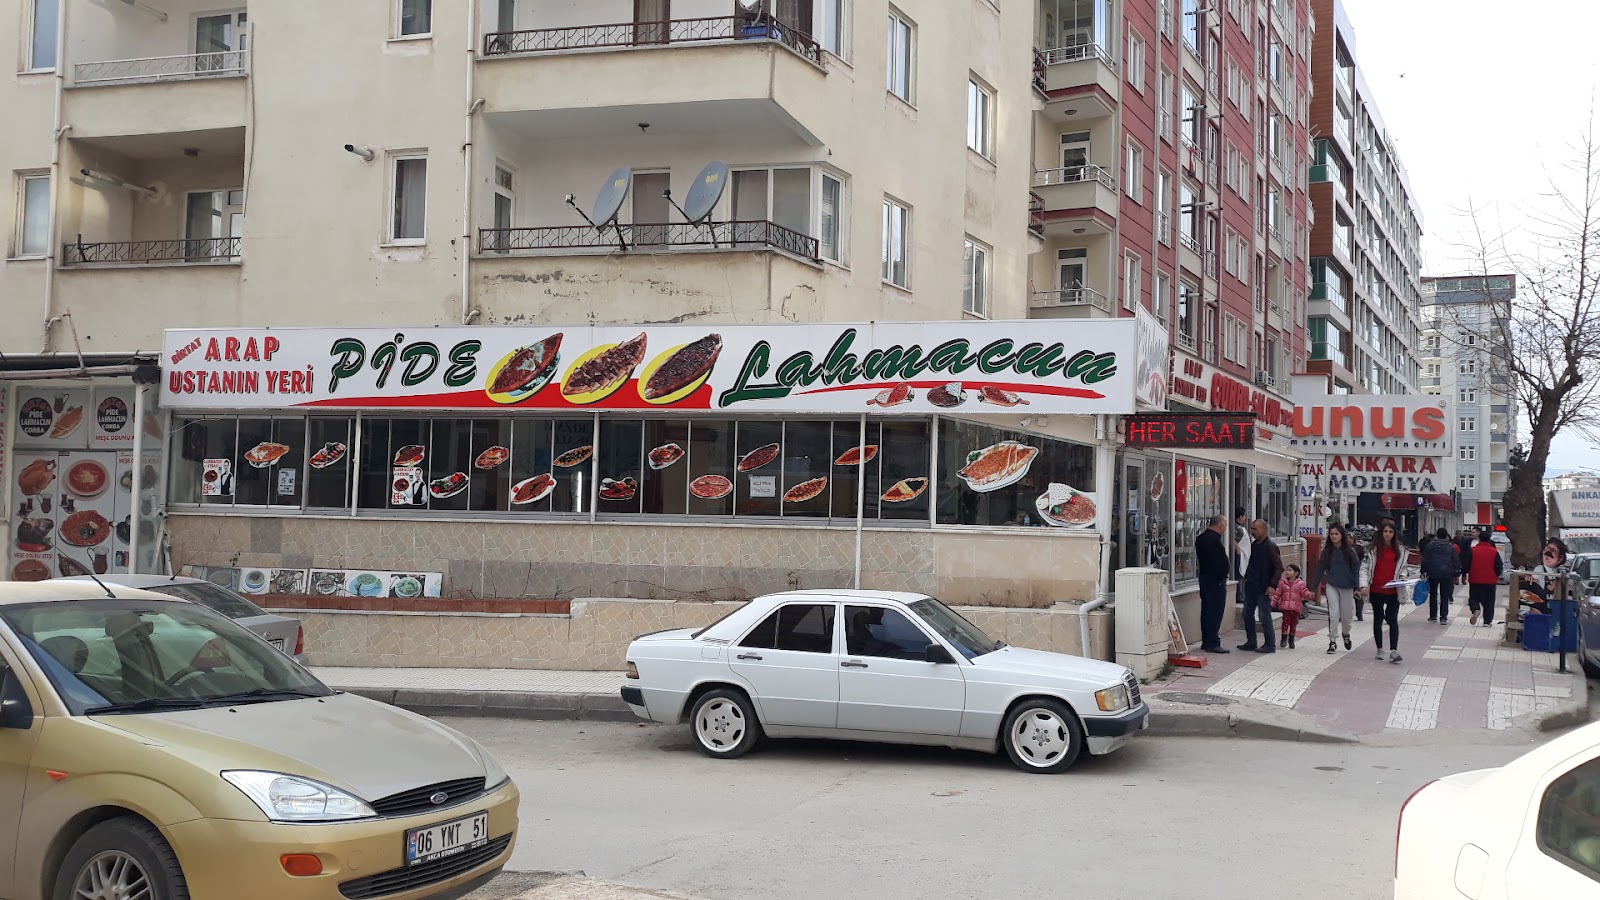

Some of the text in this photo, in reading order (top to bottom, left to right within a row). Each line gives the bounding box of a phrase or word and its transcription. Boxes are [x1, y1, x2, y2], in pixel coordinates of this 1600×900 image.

[170, 337, 203, 365] BİRTAT
[204, 336, 280, 362] ARAP
[328, 332, 483, 394] PİDE
[718, 327, 1118, 408] Lahmacun
[168, 364, 314, 394] USTANIN YERİ
[21, 418, 51, 426] LAHMACUN
[29, 409, 44, 418] PİDE
[105, 408, 119, 416] PİDE
[1260, 406, 1446, 440] unus
[1130, 421, 1254, 444] HER SAAT
[1329, 455, 1438, 475] ANKARA
[1330, 473, 1437, 492] MOBİLYA
[417, 831, 432, 854] 06
[441, 823, 461, 848] YNT
[473, 816, 485, 839] 51
